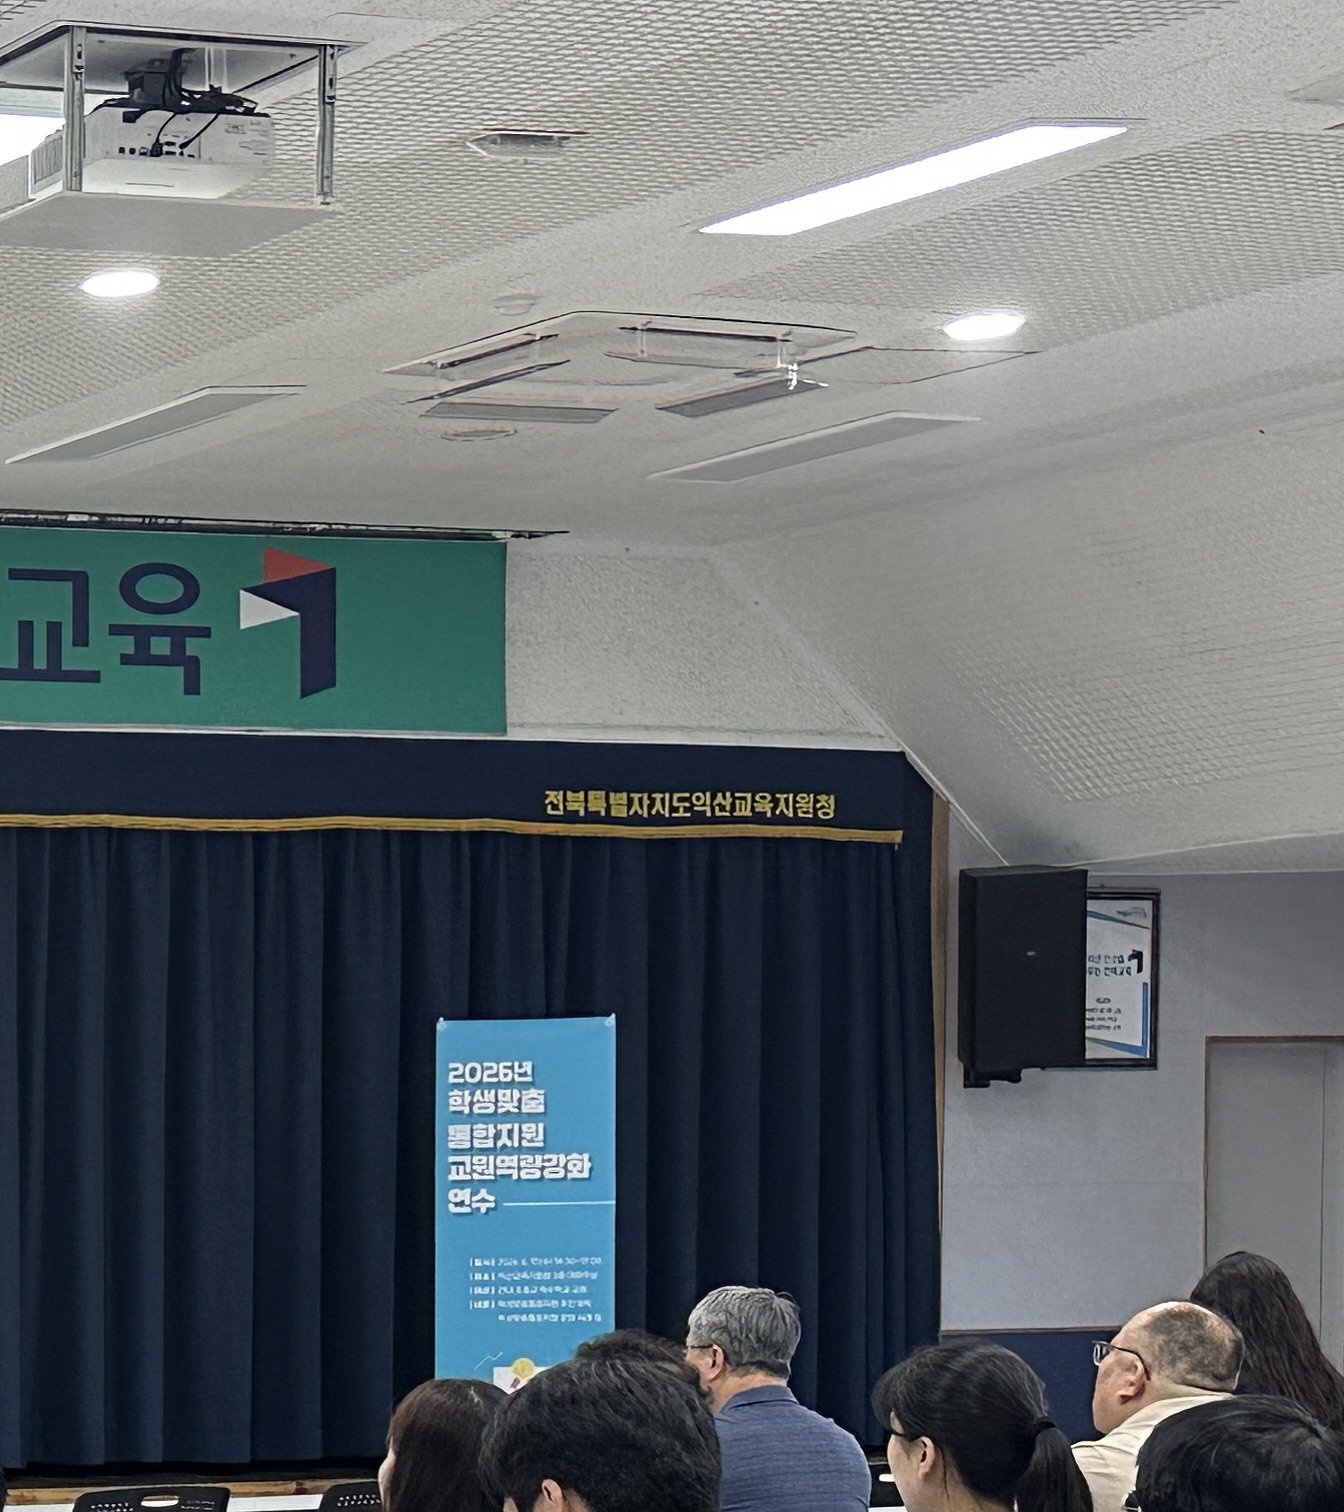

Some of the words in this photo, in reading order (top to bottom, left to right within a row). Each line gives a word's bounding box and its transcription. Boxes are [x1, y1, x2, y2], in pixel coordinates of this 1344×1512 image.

[448, 1060, 533, 1084] 2026년
[448, 1087, 545, 1115] 학생맞춤
[447, 1122, 545, 1150] 통합지원
[447, 1187, 496, 1214] 연수
